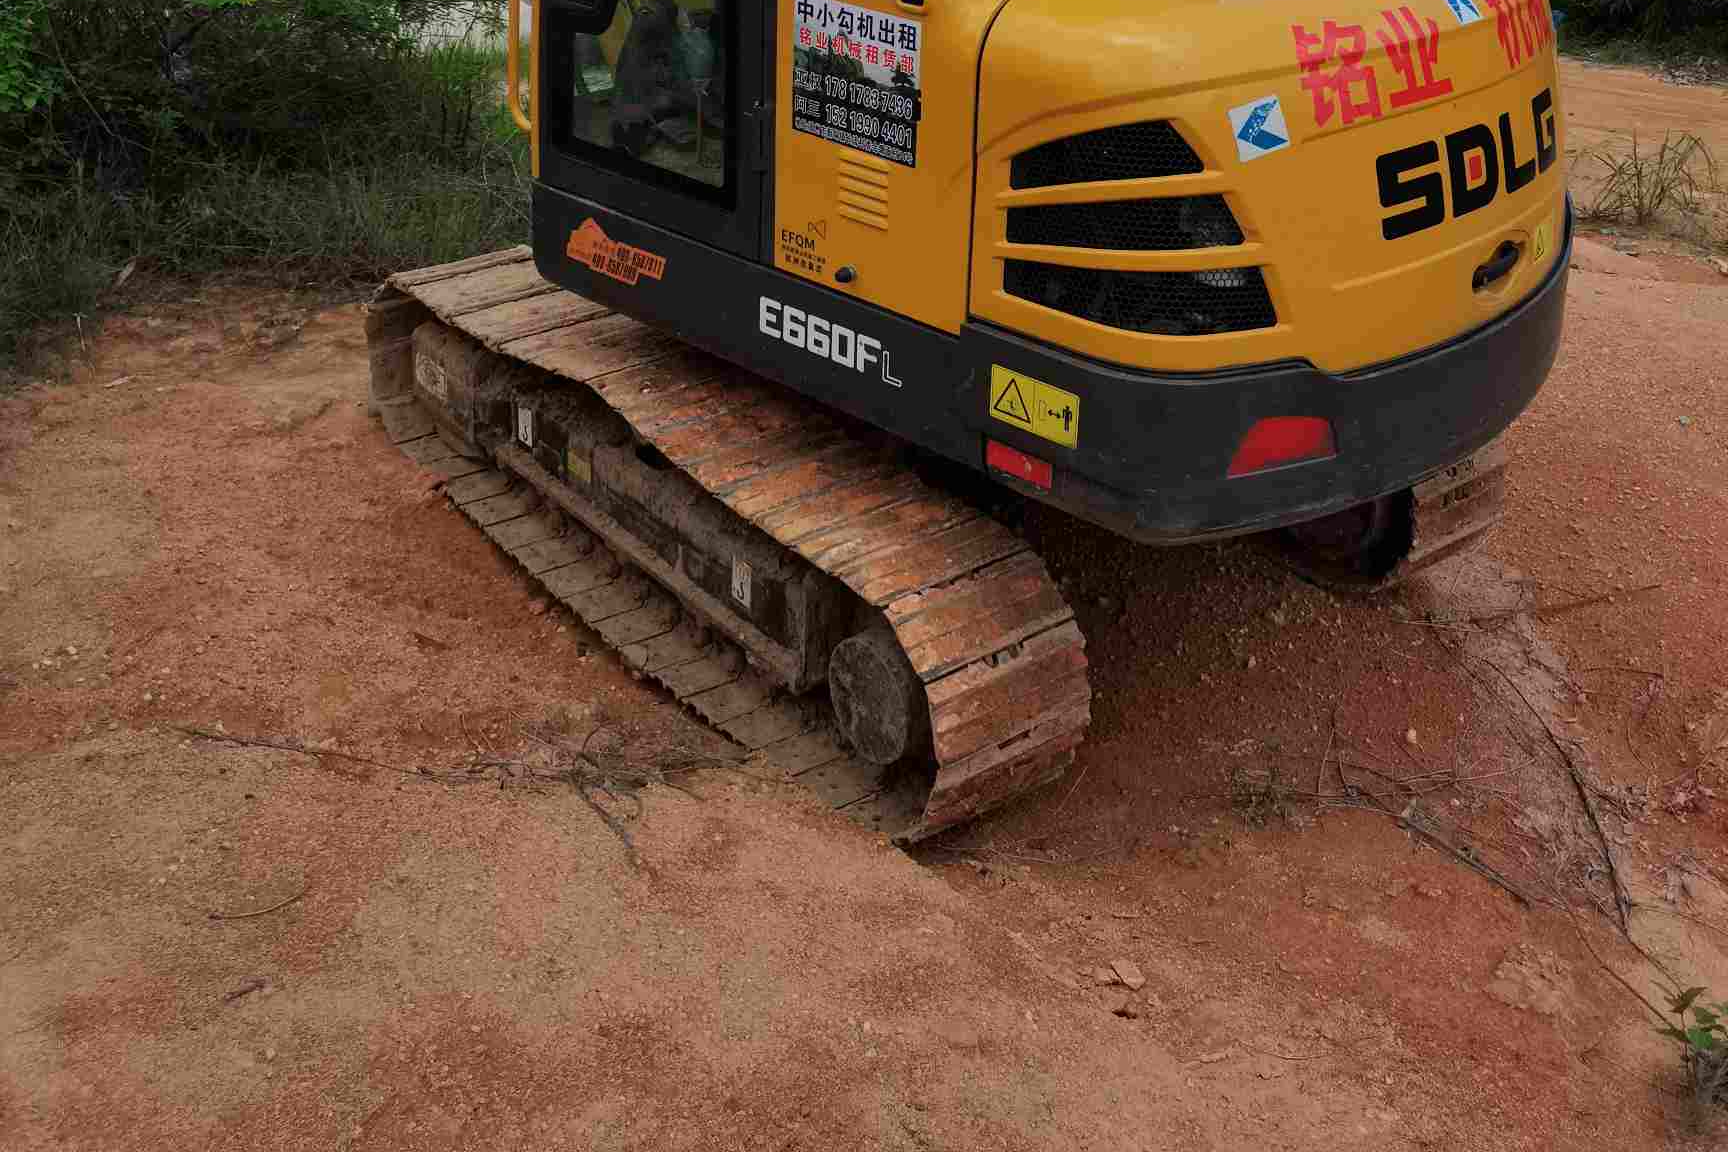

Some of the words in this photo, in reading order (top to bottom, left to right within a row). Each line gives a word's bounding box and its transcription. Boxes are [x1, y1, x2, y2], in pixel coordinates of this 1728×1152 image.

[825, 74, 848, 100] 178
[1291, 6, 1454, 129] 铭业
[825, 103, 848, 129] 152
[849, 110, 880, 138] 1990
[880, 121, 913, 149] 4401
[1376, 87, 1556, 240] SDLG
[781, 228, 815, 251] EFQM
